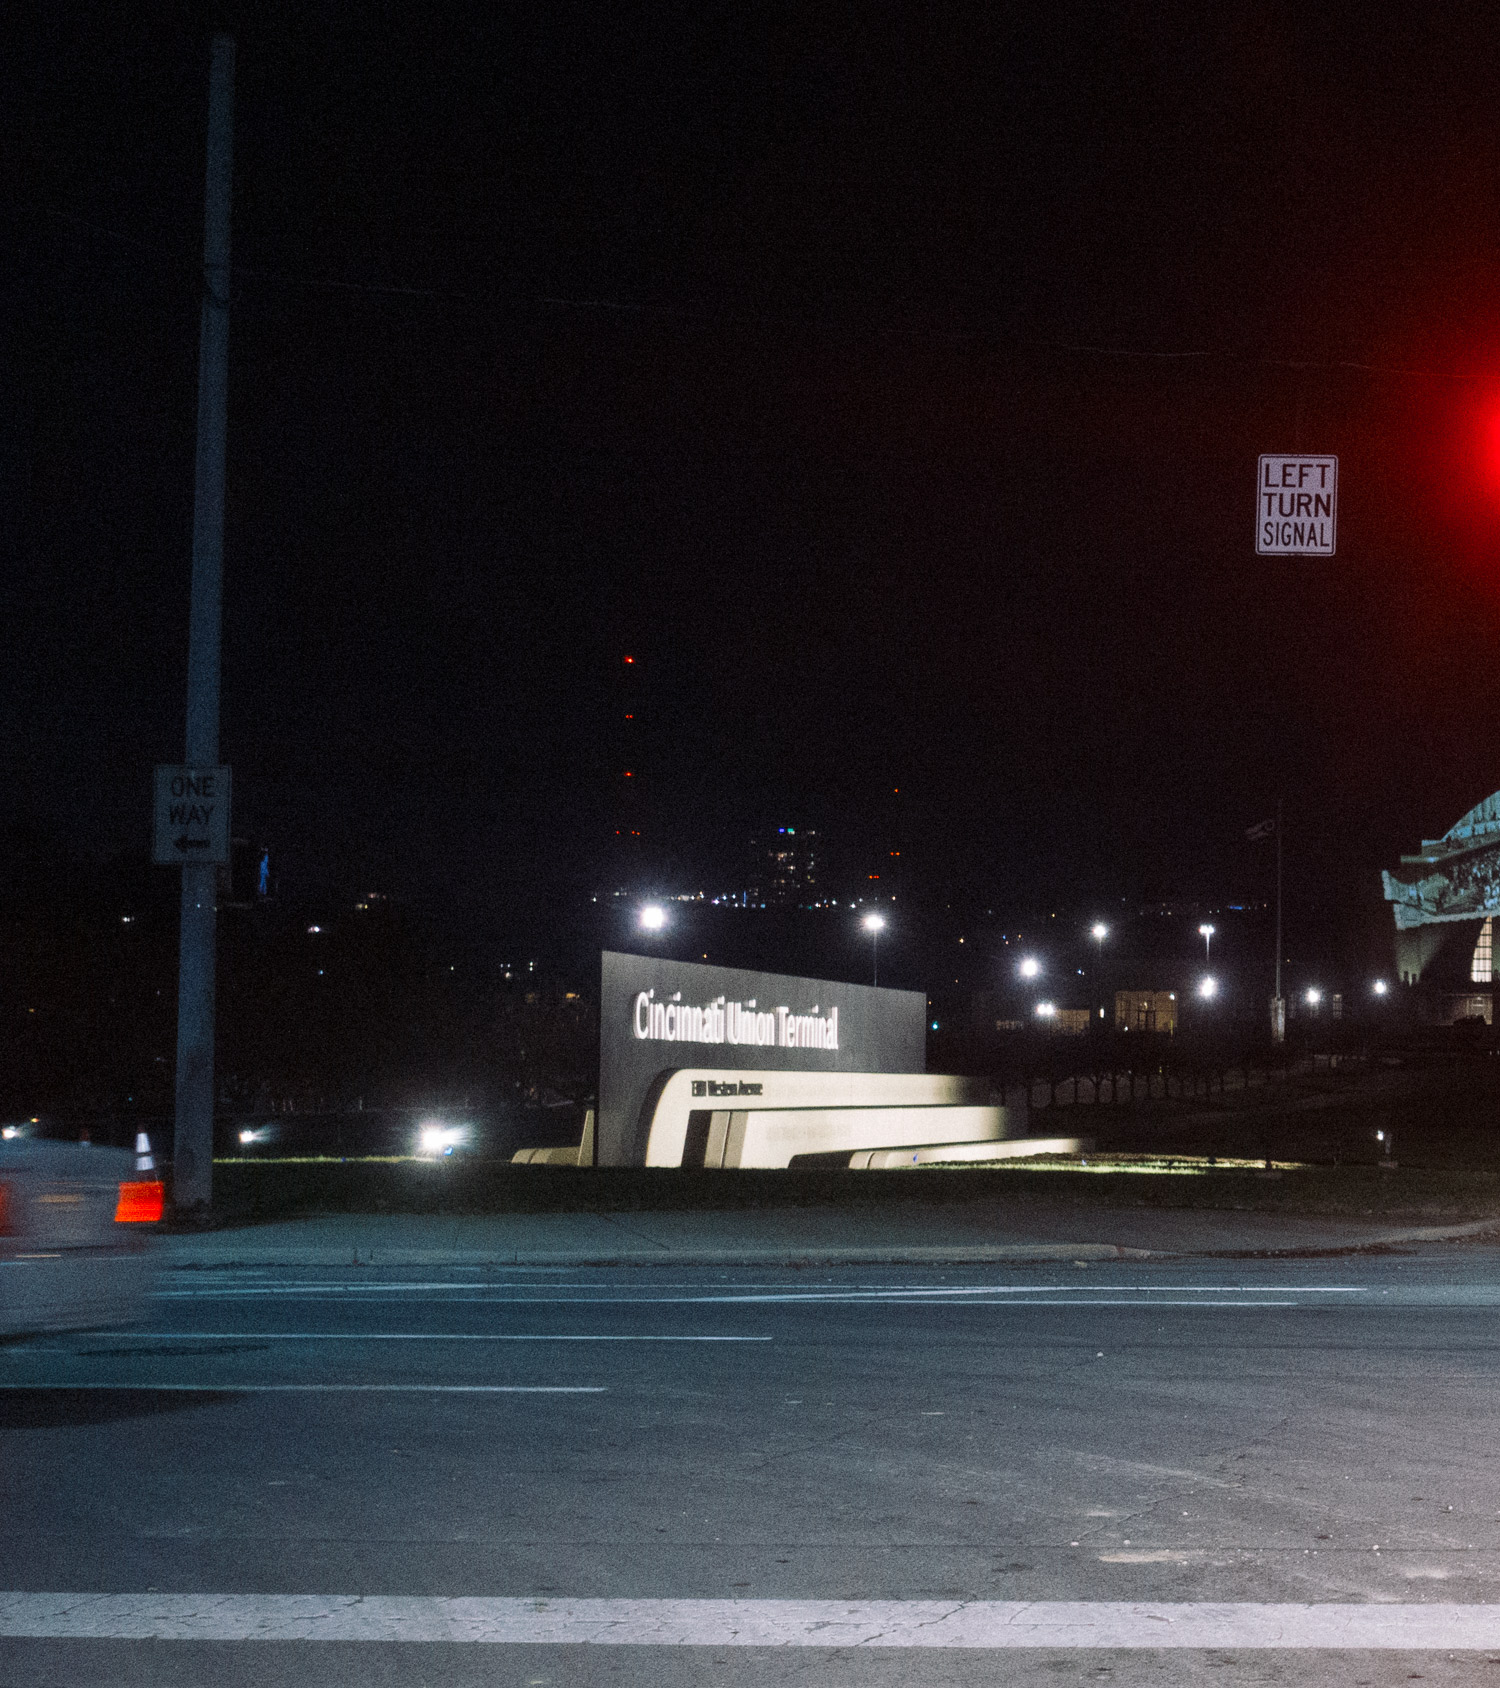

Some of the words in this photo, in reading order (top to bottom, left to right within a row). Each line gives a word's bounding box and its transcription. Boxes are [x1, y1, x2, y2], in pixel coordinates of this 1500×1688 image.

[1265, 463, 1331, 488] LEFT
[1262, 492, 1332, 518] TURN
[1263, 521, 1330, 547] SIGNAL
[171, 776, 217, 798] ONE
[169, 804, 216, 825] WAY
[634, 988, 725, 1043] Cincinnati
[727, 998, 775, 1046] Union
[776, 1005, 839, 1050] Terminal
